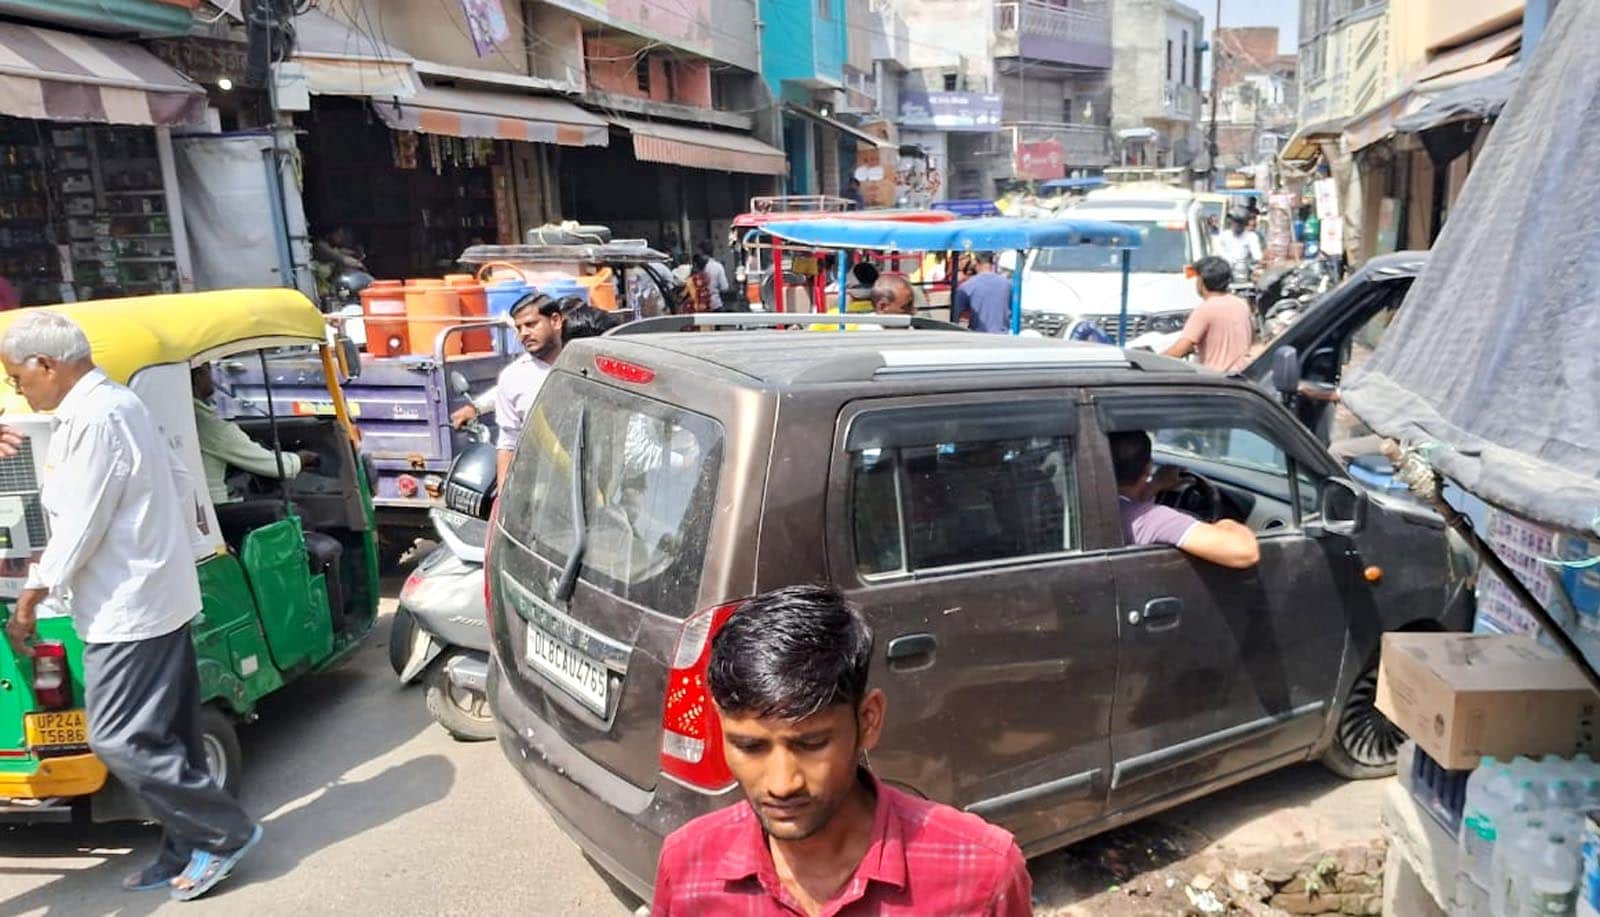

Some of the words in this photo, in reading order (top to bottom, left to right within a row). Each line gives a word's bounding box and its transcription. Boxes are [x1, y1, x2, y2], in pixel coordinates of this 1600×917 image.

[534, 631, 606, 697] DL8CAU4765
[38, 714, 82, 729] UP24A
[39, 729, 85, 743] T5686
